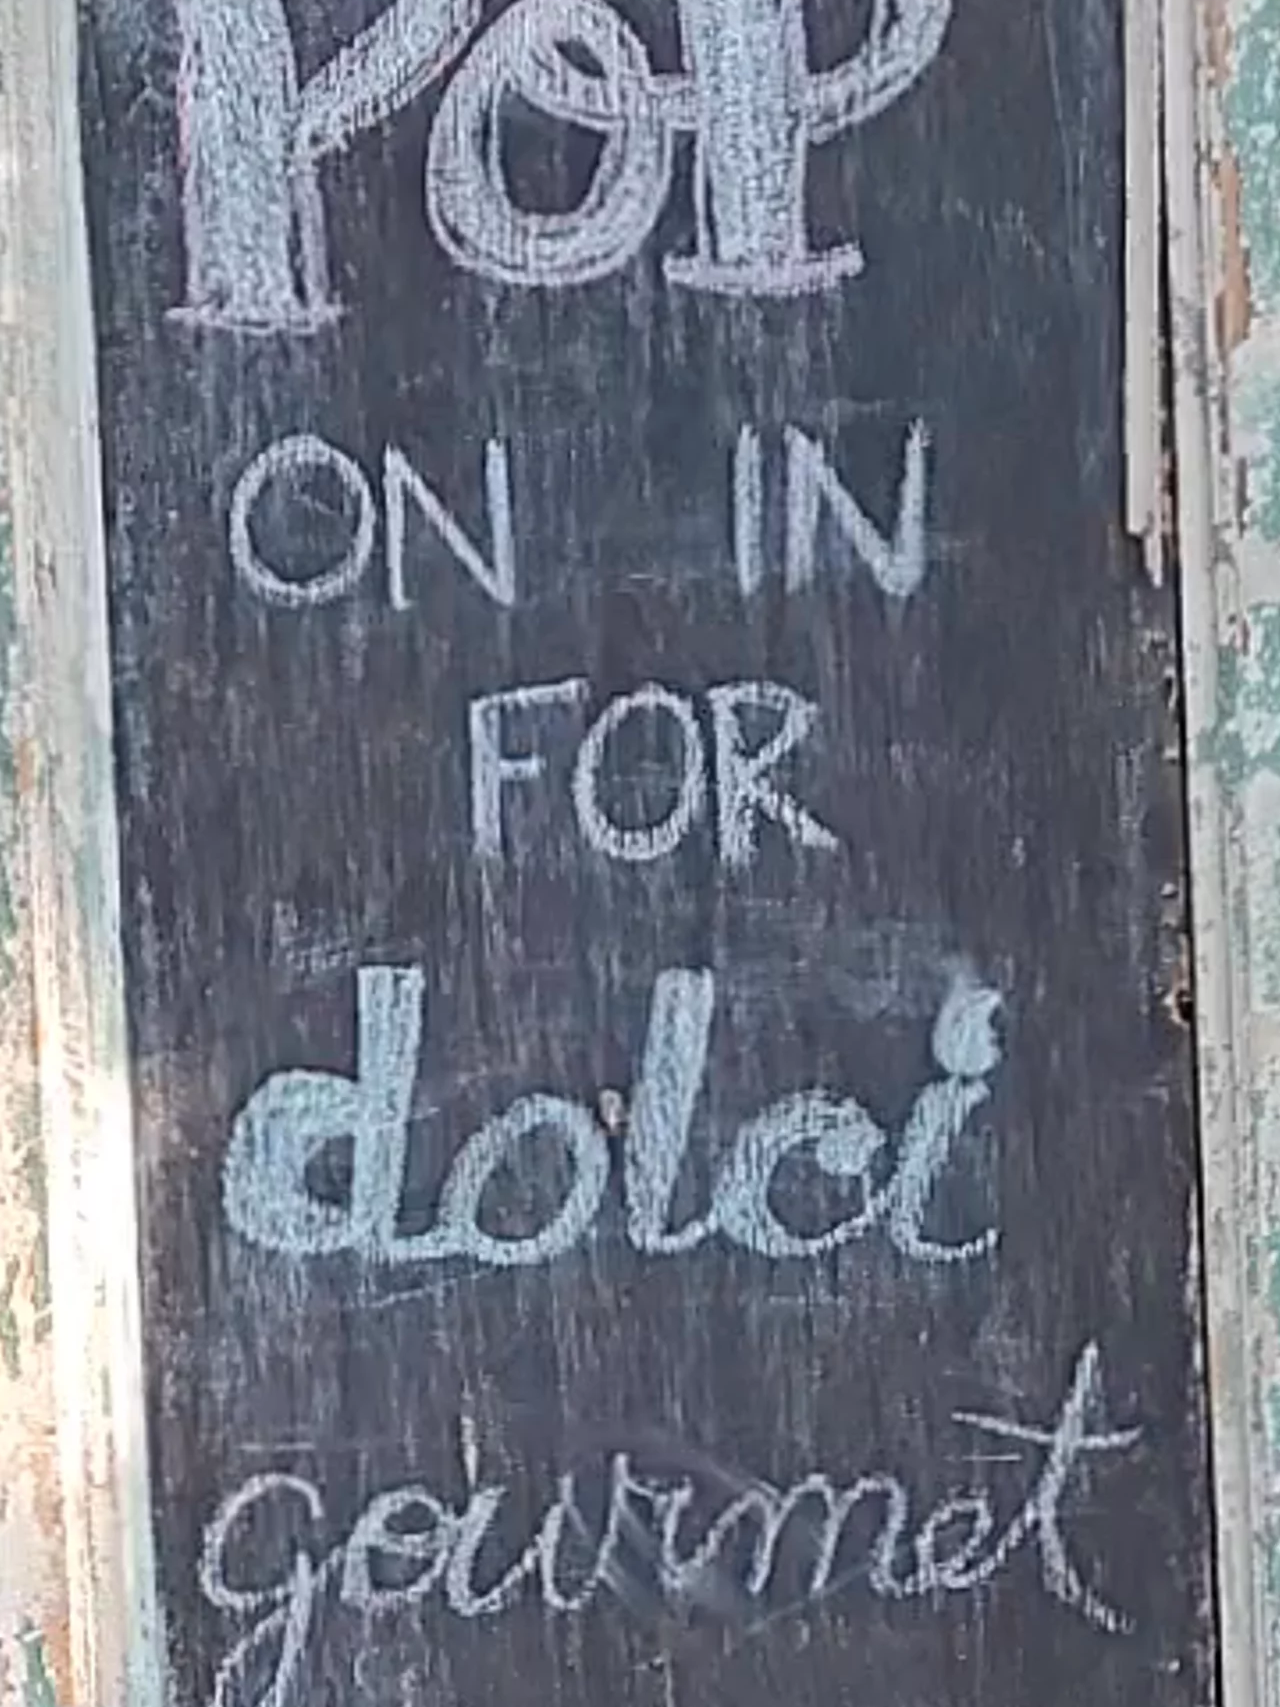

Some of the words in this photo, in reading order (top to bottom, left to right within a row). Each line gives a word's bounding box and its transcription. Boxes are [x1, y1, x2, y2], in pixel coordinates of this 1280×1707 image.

[229, 433, 518, 611] ON
[734, 417, 923, 597] IN
[469, 677, 839, 868] FOR
[222, 965, 1003, 1265] dolci
